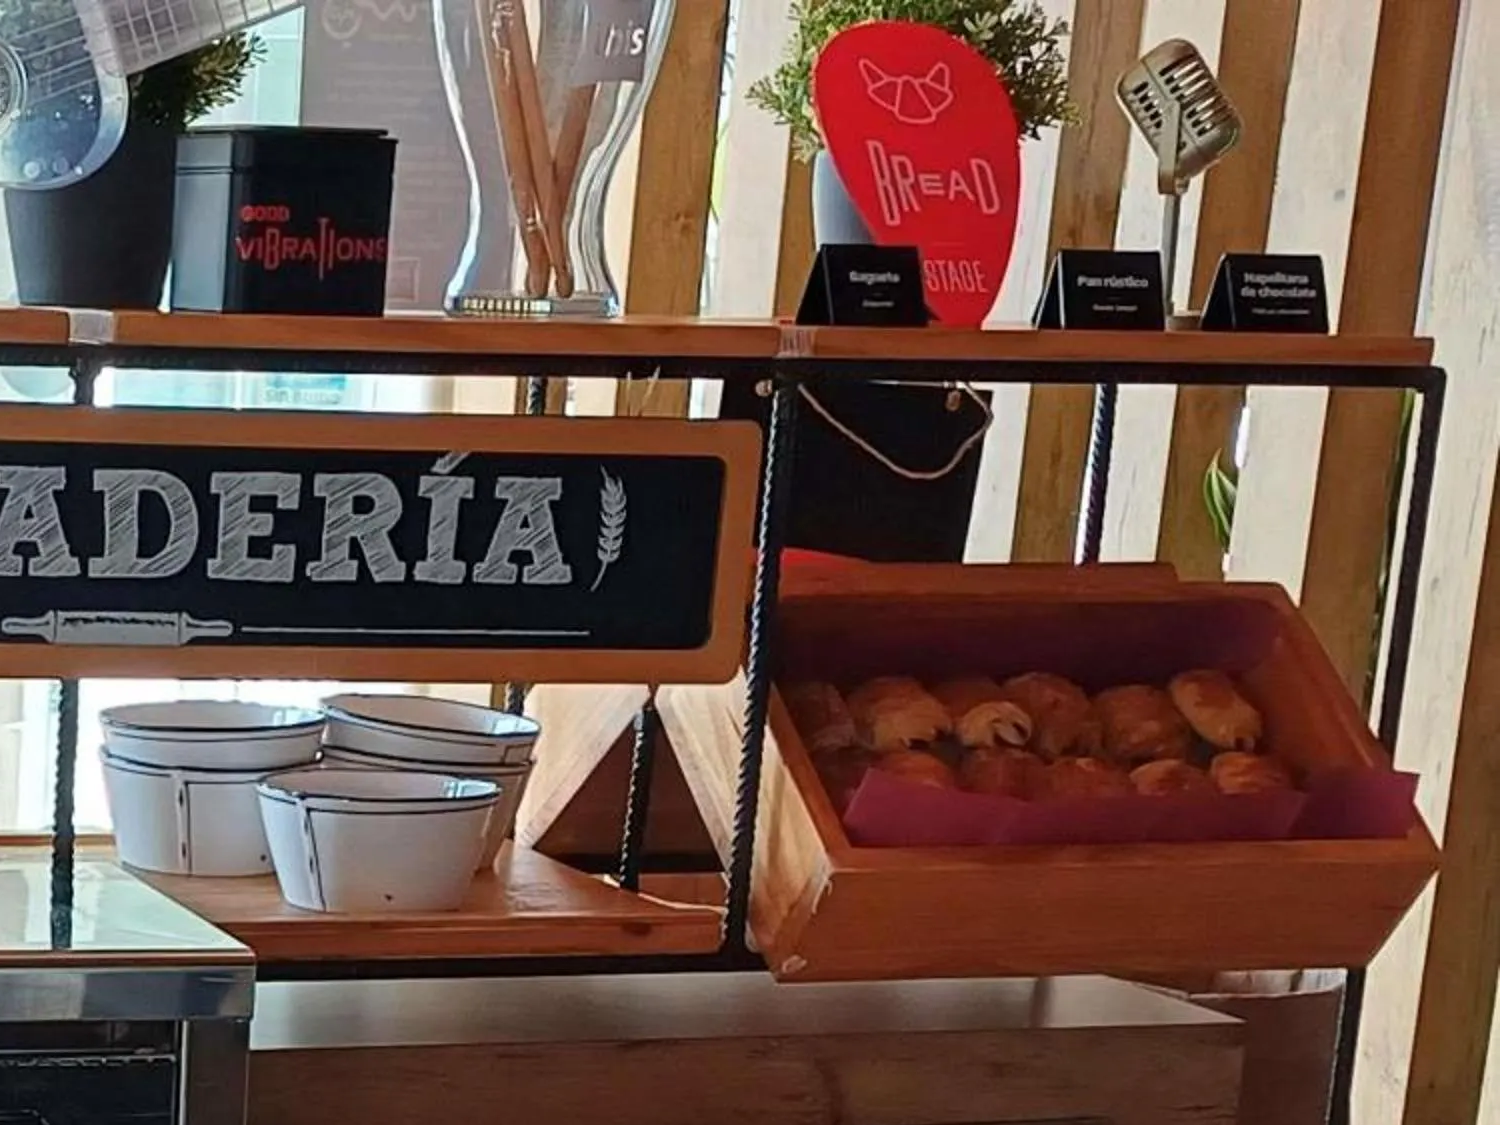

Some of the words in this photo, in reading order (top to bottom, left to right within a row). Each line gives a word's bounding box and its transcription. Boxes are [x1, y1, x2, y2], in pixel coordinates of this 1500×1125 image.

[866, 140, 999, 226] BREAD
[235, 217, 388, 281] VIBRATIONS
[923, 259, 990, 294] STAGE
